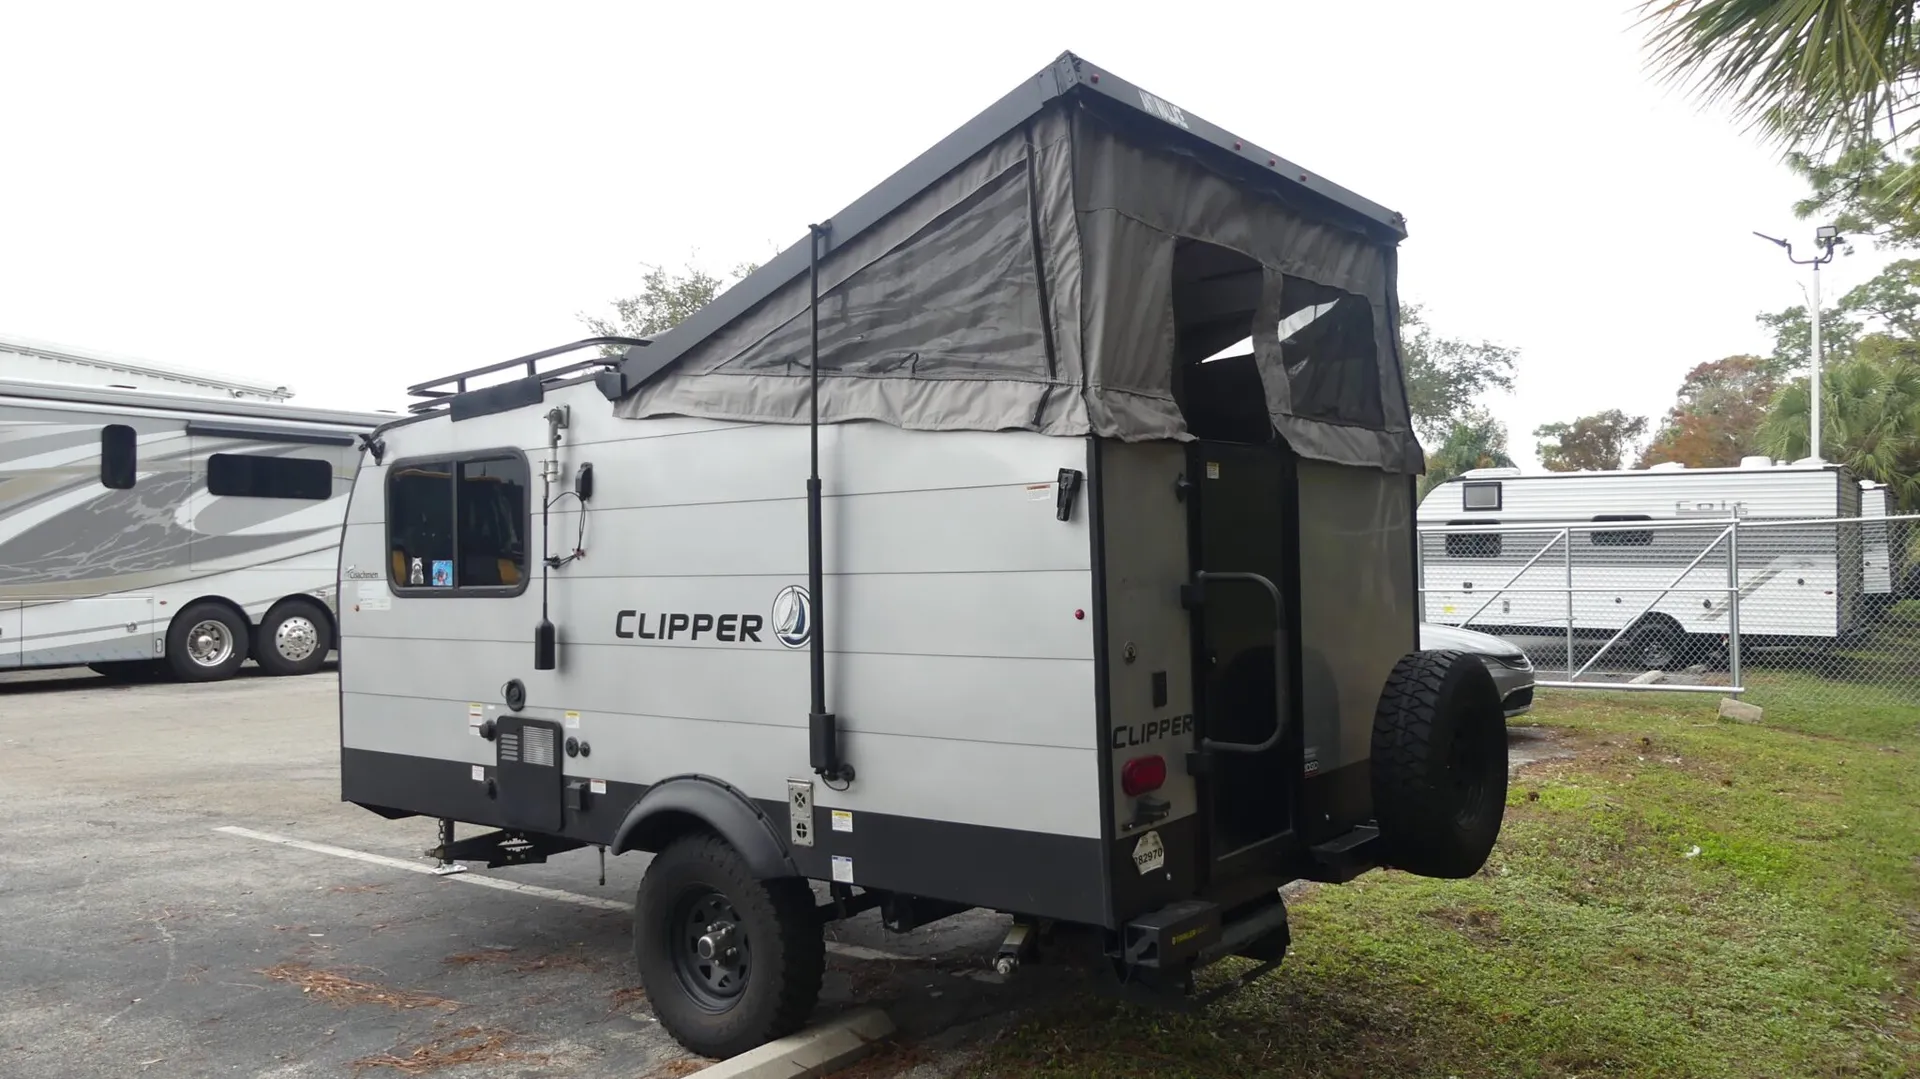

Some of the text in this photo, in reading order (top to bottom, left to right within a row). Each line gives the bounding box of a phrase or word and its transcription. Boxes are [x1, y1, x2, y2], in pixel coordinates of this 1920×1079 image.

[349, 571, 379, 579] Coachmen
[615, 609, 763, 643] CLIPPER
[1112, 713, 1193, 749] CLIPPER
